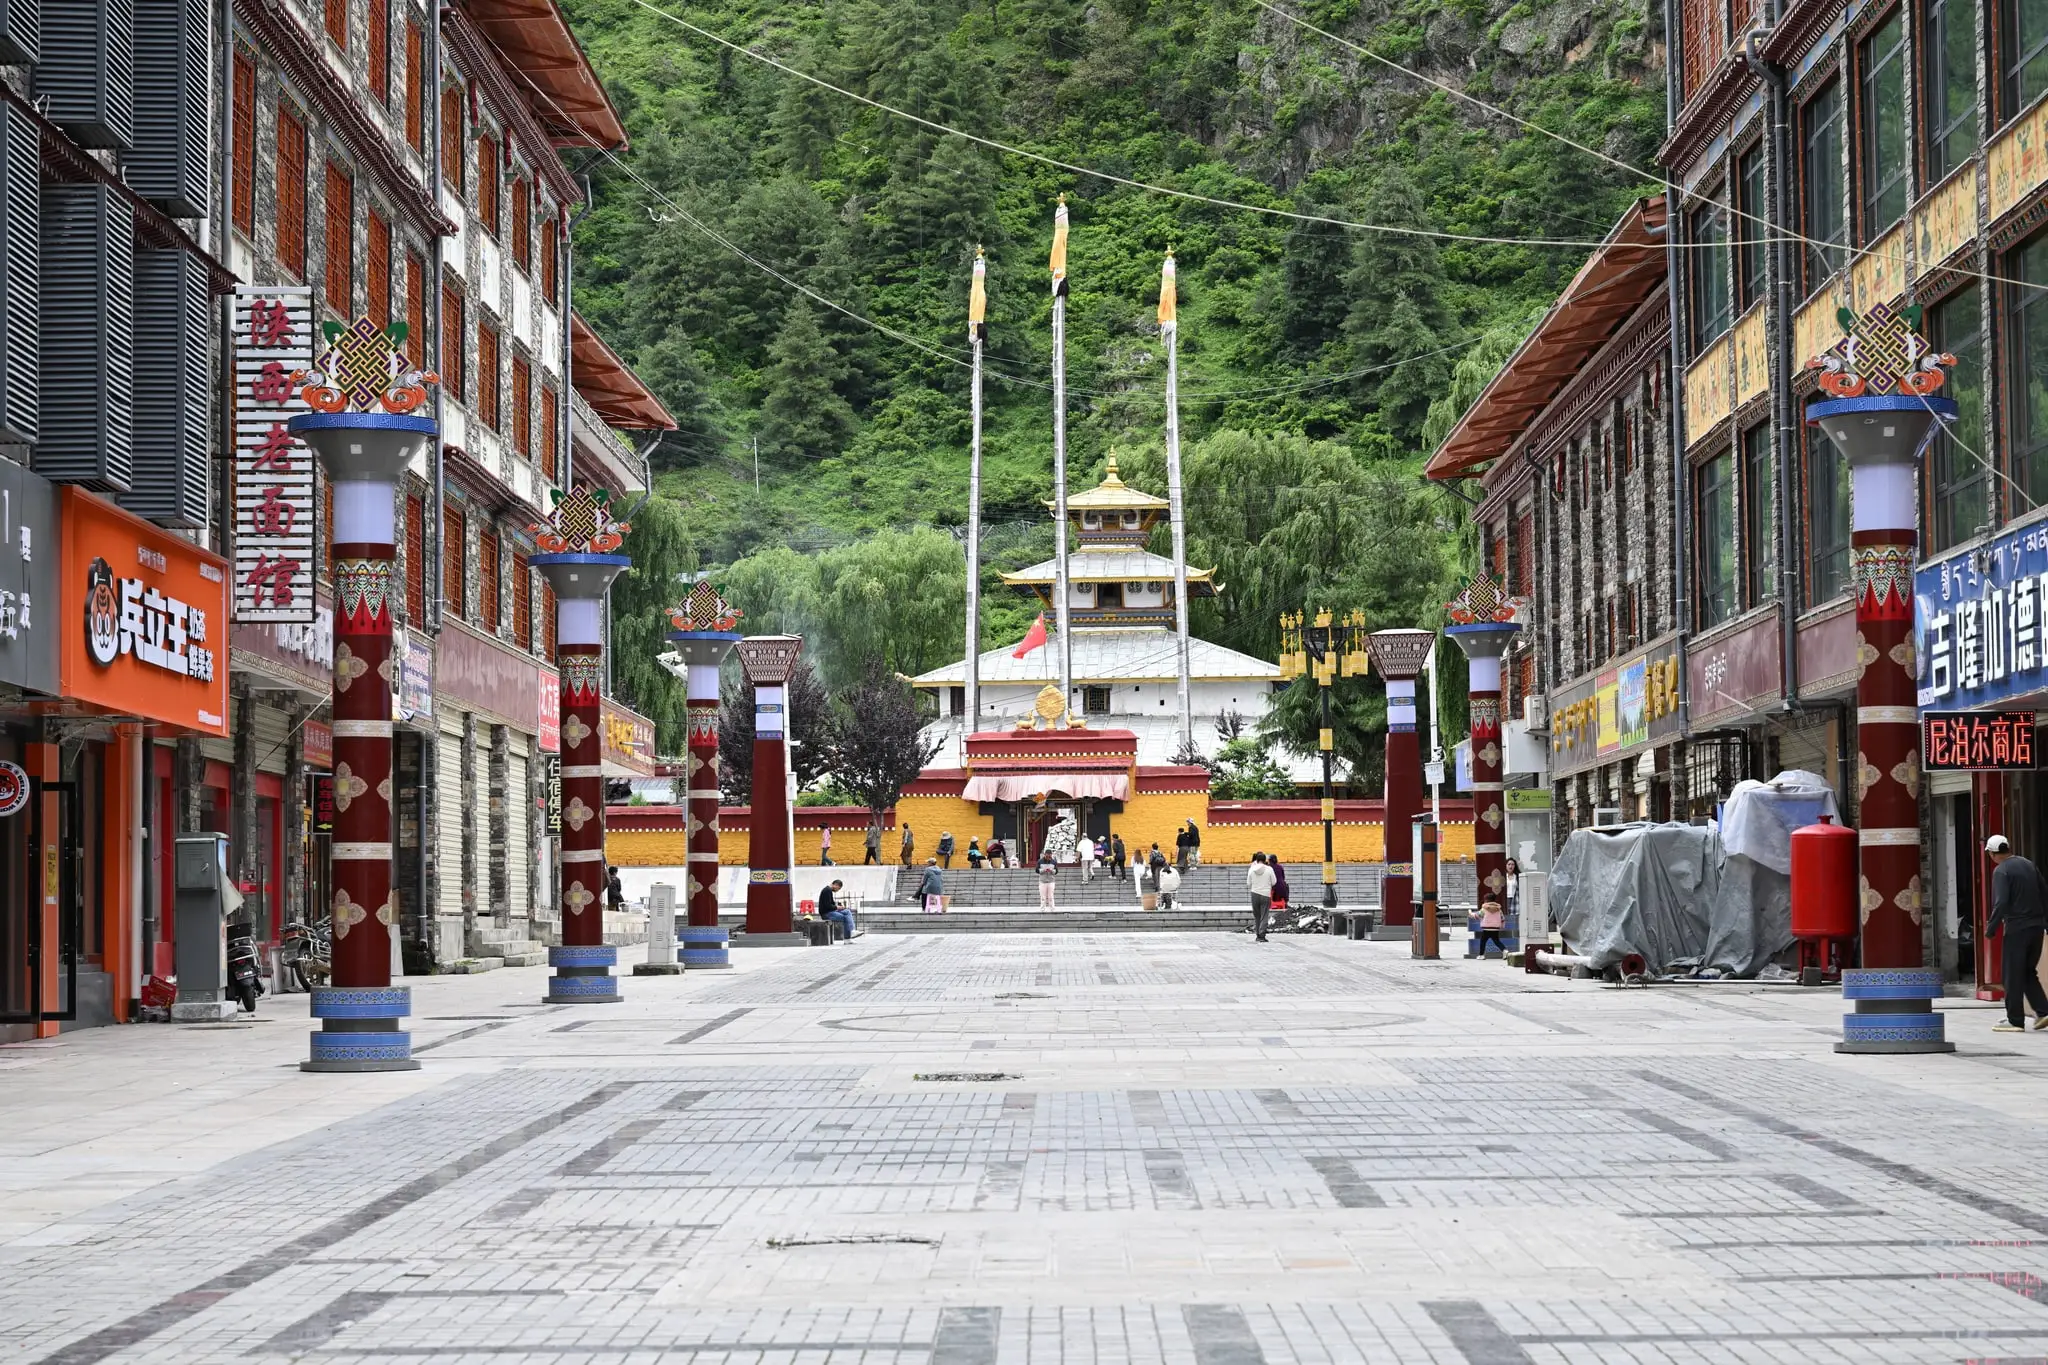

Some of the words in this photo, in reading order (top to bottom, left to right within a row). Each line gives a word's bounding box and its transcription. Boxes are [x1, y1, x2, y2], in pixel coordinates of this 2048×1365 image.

[246, 300, 300, 607] 陕西老面馆
[1929, 715, 2032, 766] 尼泊尔商店
